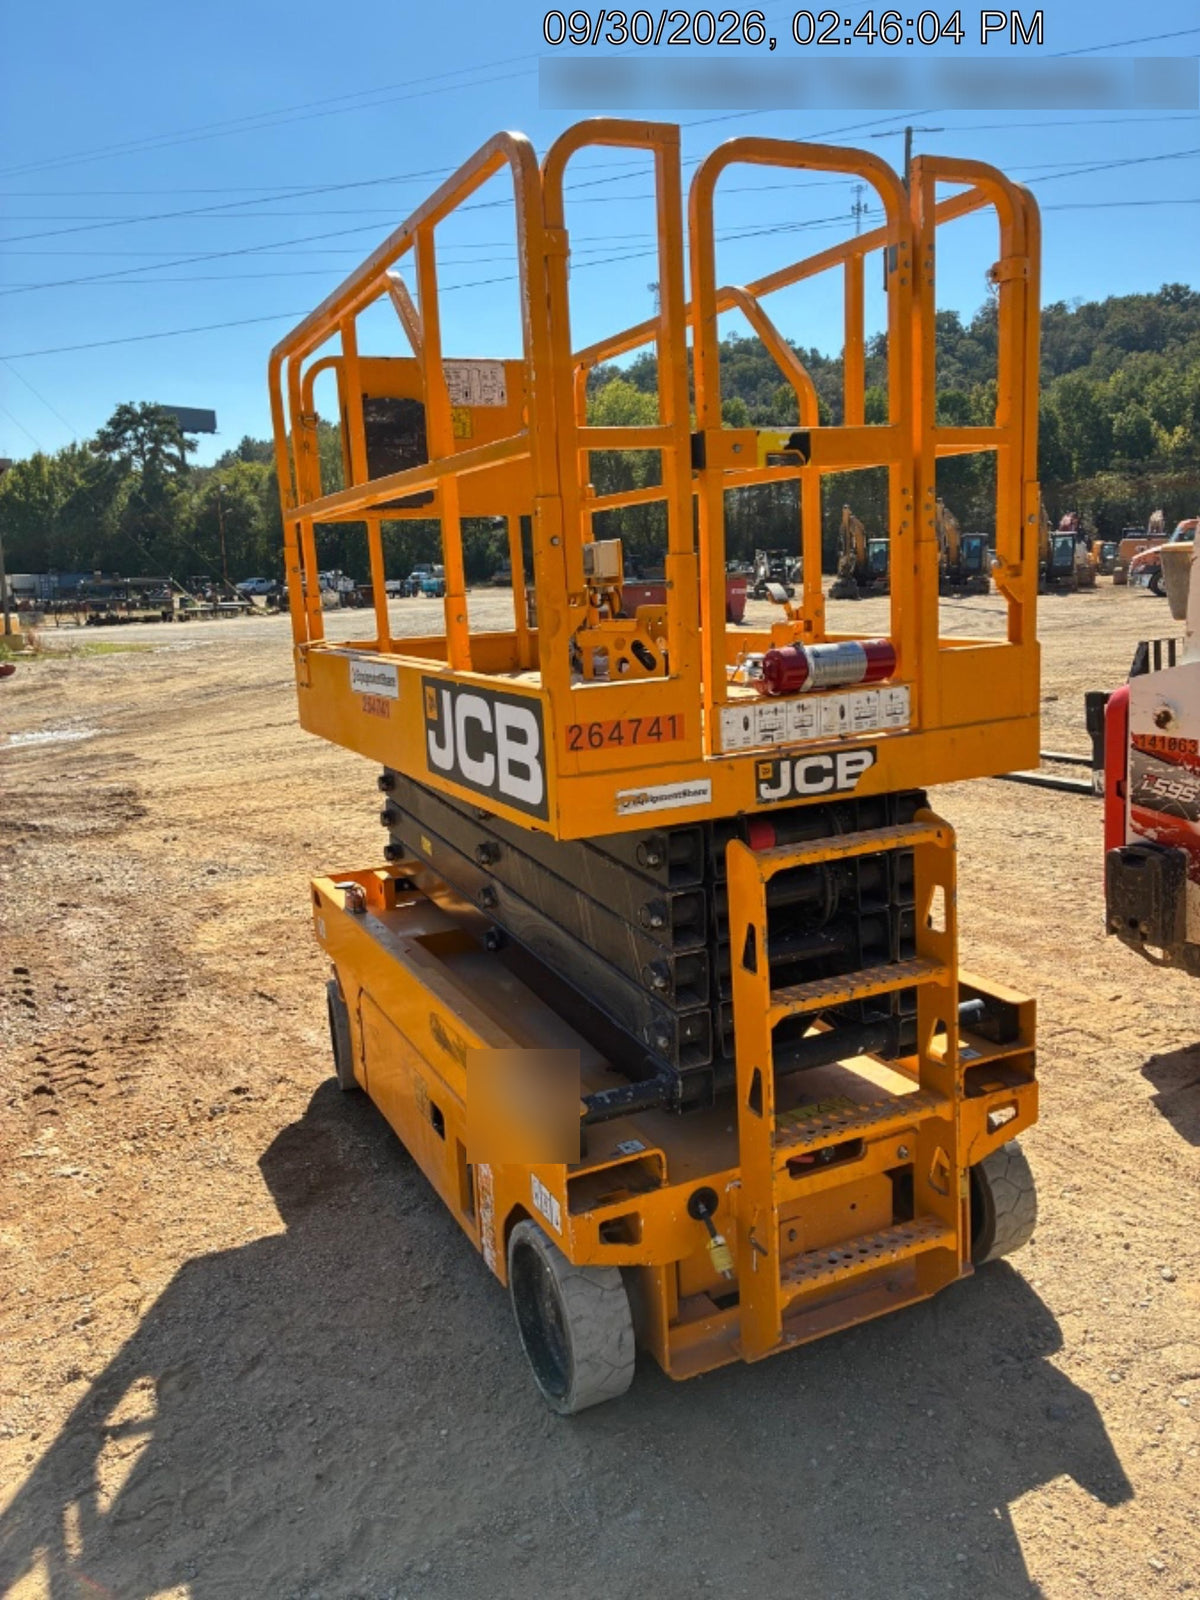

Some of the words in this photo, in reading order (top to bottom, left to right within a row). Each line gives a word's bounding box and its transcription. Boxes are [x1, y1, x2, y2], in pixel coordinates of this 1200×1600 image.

[428, 689, 543, 805] JCB
[568, 714, 678, 751] 264741
[759, 750, 874, 799] JCB
